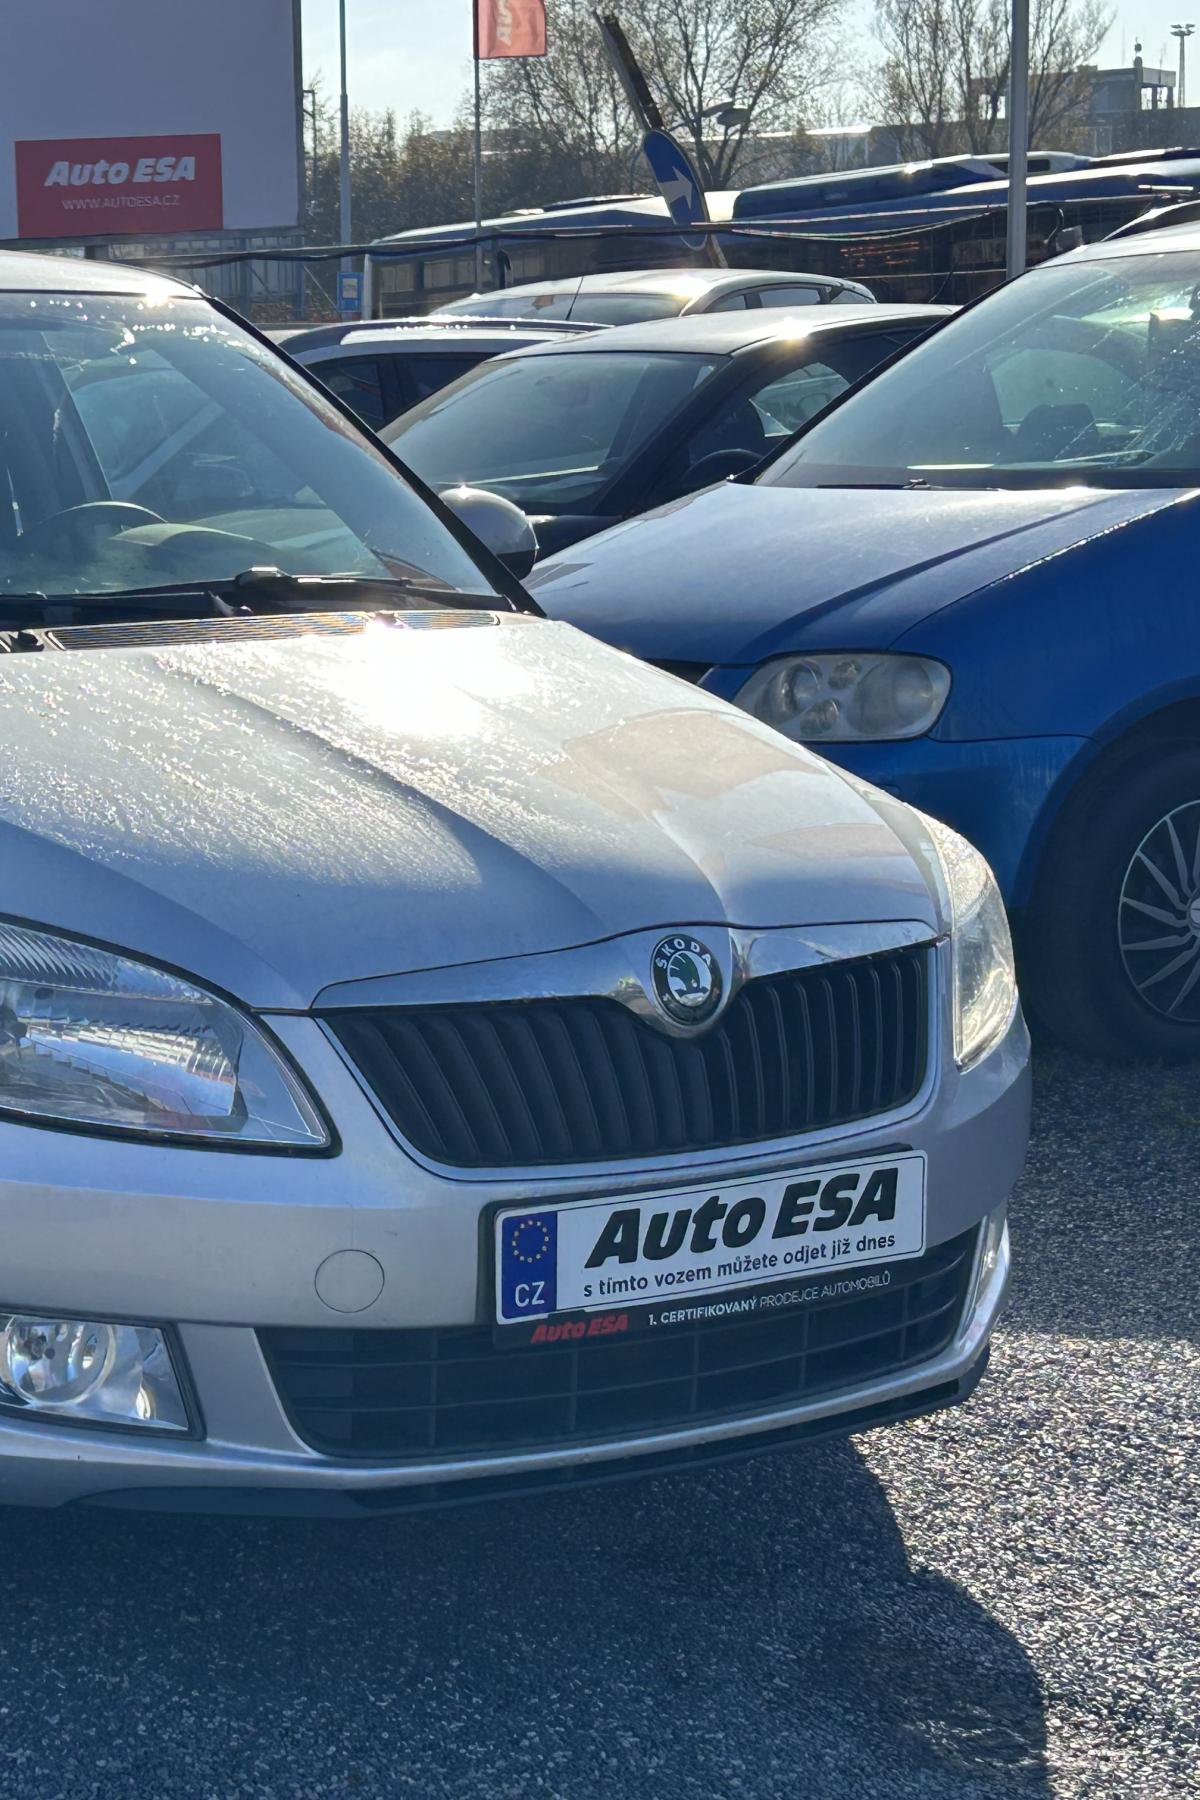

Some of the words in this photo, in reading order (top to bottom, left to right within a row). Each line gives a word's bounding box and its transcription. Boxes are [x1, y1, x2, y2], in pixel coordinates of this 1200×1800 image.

[43, 158, 130, 187] Auto
[132, 155, 196, 184] ESA
[61, 194, 181, 210] WWW.AUTOESA.CZ
[584, 1195, 766, 1270] Auto
[771, 1167, 899, 1240] ESA
[583, 1284, 593, 1298] s
[599, 1276, 649, 1296] tímto
[654, 1266, 712, 1288] vozem
[717, 1255, 778, 1278] můžete
[783, 1243, 827, 1265] odjet
[830, 1238, 851, 1260] již
[856, 1234, 896, 1252] dnes
[514, 1280, 545, 1308] CZ
[660, 1296, 757, 1325] CERTIFIKOVANÝ
[759, 1286, 819, 1308] PRODEJCE
[820, 1270, 891, 1297] AUTOMOBILŮ
[530, 1321, 586, 1344] Auto
[588, 1314, 629, 1336] ESA
